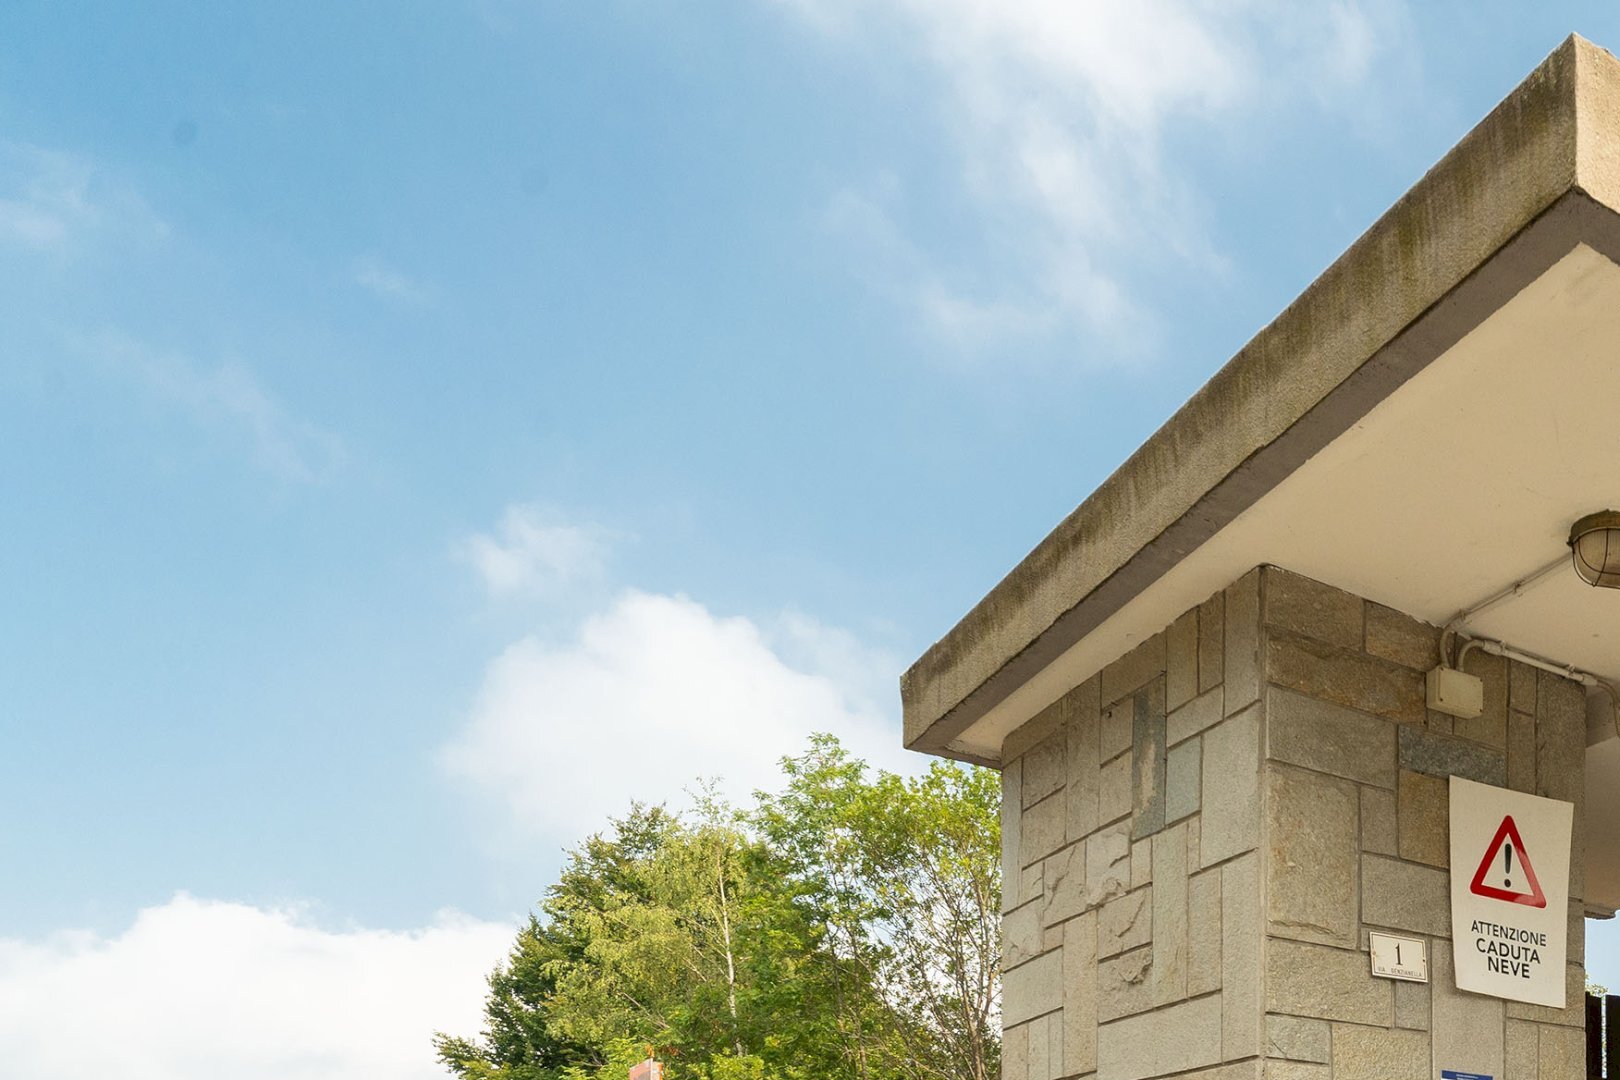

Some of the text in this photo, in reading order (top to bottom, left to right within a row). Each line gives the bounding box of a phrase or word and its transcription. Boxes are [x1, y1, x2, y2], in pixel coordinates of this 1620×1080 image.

[1471, 920, 1547, 947] ATTENZIONE
[1395, 943, 1403, 966] 1
[1476, 938, 1541, 964] CADUTA
[1487, 957, 1531, 979] NEVE
